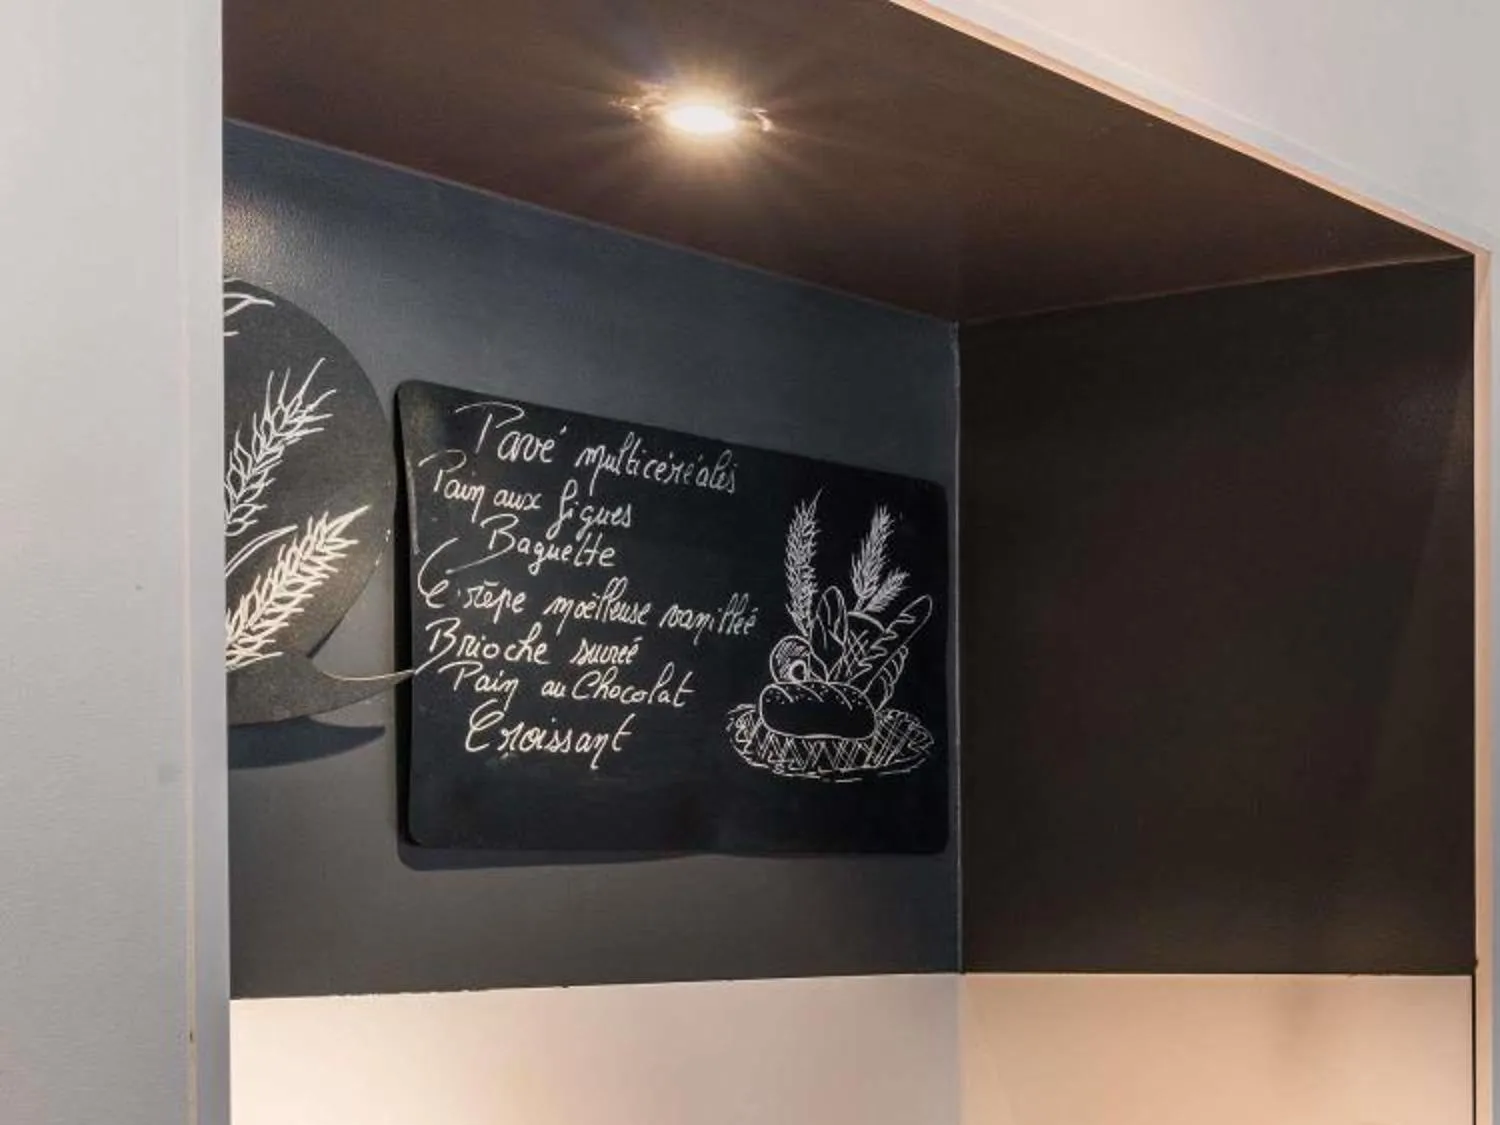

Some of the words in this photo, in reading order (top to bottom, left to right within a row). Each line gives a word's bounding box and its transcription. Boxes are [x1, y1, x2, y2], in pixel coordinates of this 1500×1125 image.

[455, 401, 567, 464] Pavé
[418, 449, 485, 524] Pain
[493, 487, 542, 511] aux
[545, 479, 632, 540] figues
[445, 513, 616, 576] Baguette
[413, 617, 551, 676] Brioche
[438, 660, 519, 711] Pain
[541, 681, 567, 699] au
[571, 661, 697, 708] Chocolat
[464, 698, 637, 770] Croissant
